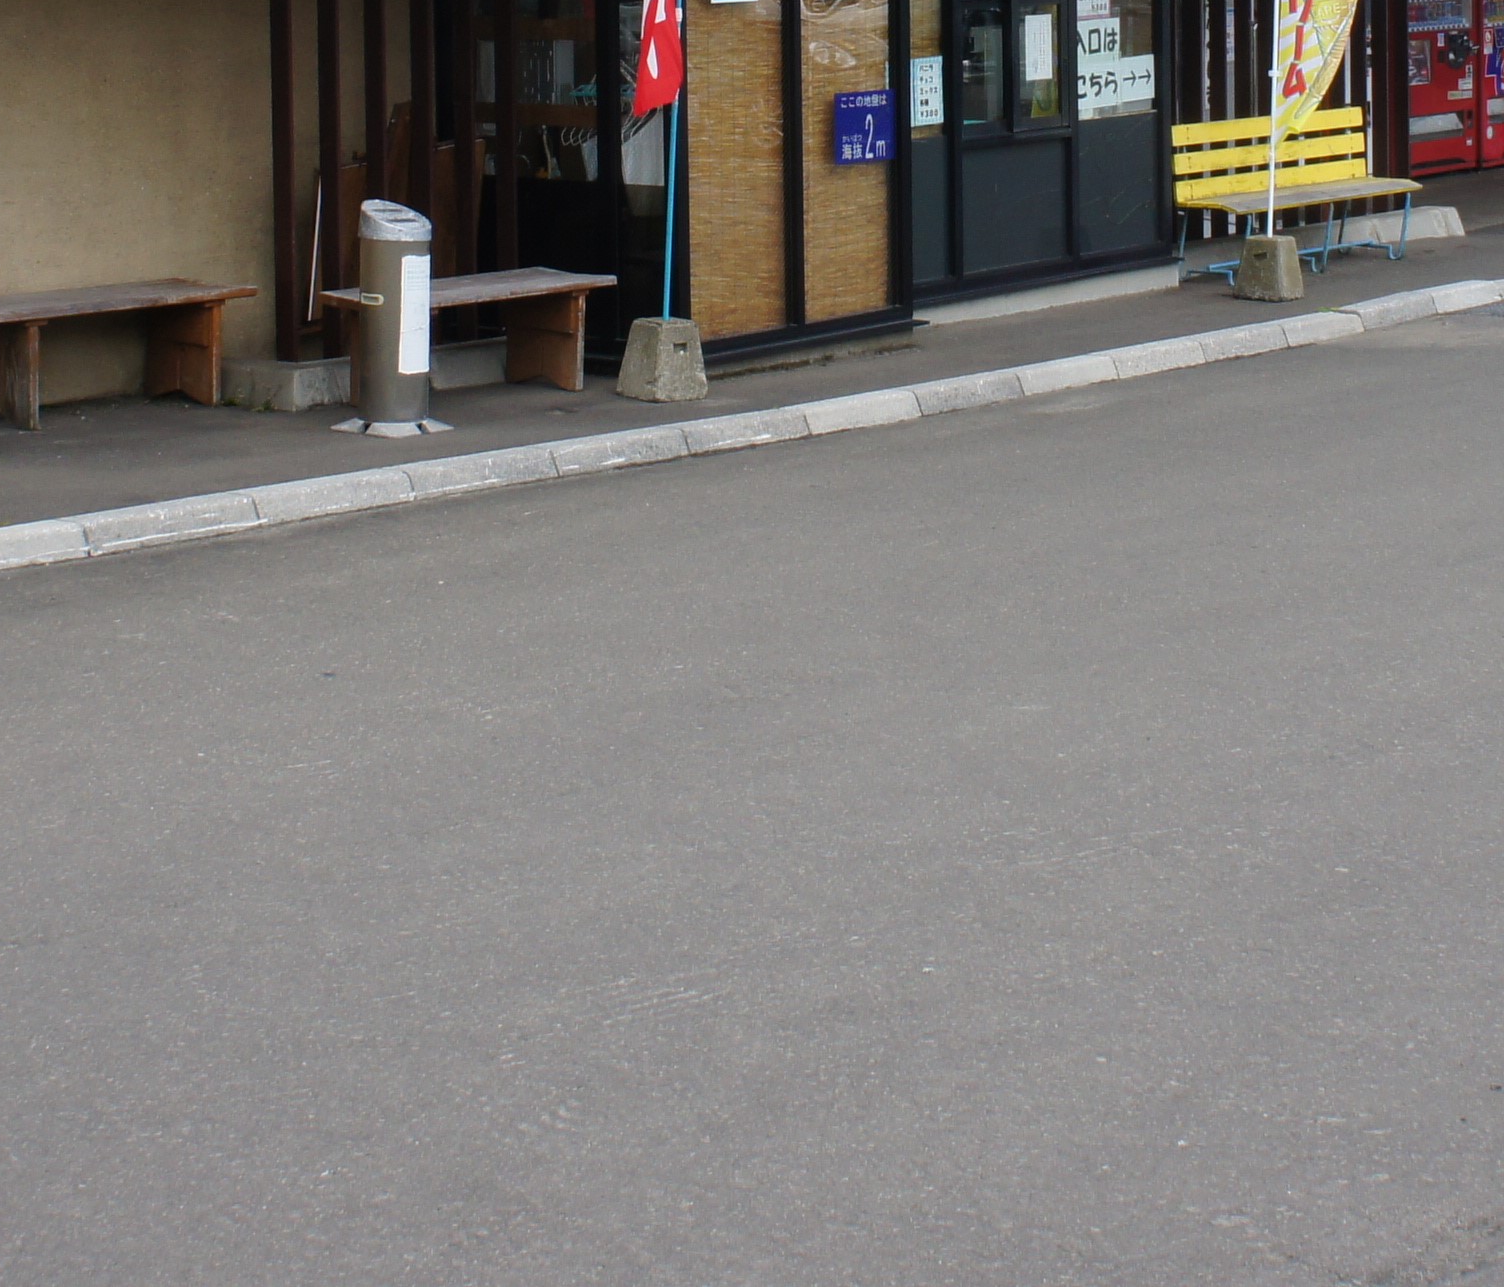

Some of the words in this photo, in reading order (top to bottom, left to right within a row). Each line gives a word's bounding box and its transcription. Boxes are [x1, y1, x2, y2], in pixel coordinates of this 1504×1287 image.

[840, 93, 887, 109] ここの地盤は
